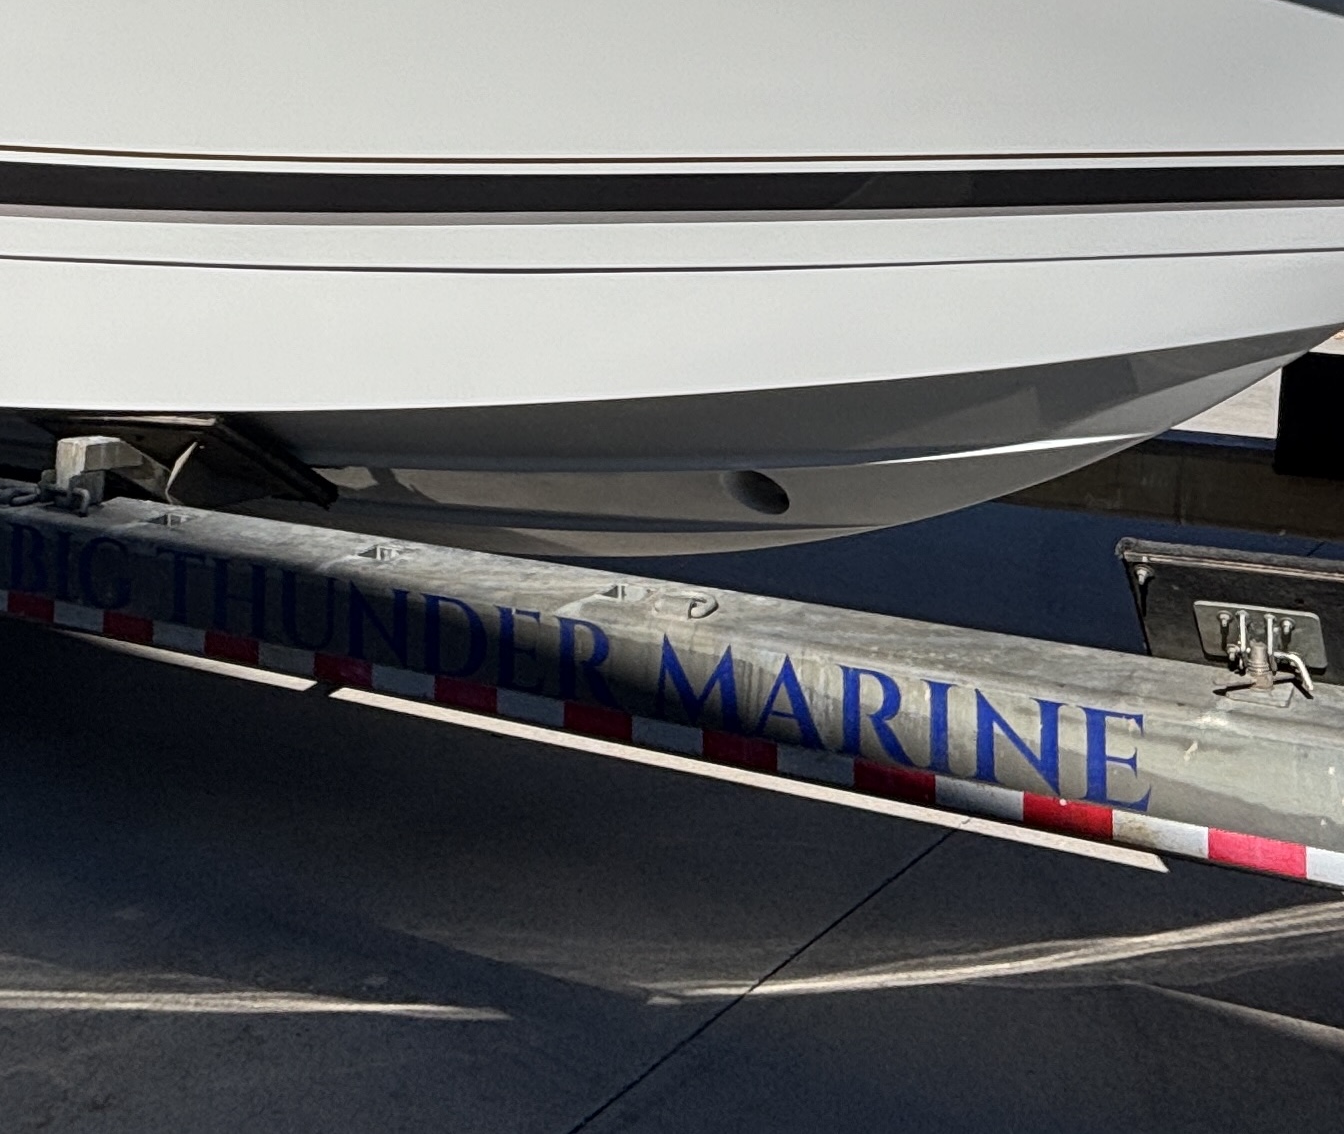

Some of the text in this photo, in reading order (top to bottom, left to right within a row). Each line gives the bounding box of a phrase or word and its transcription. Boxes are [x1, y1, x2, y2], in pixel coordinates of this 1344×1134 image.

[8, 521, 1152, 812] BIG THUNDER MARINE
